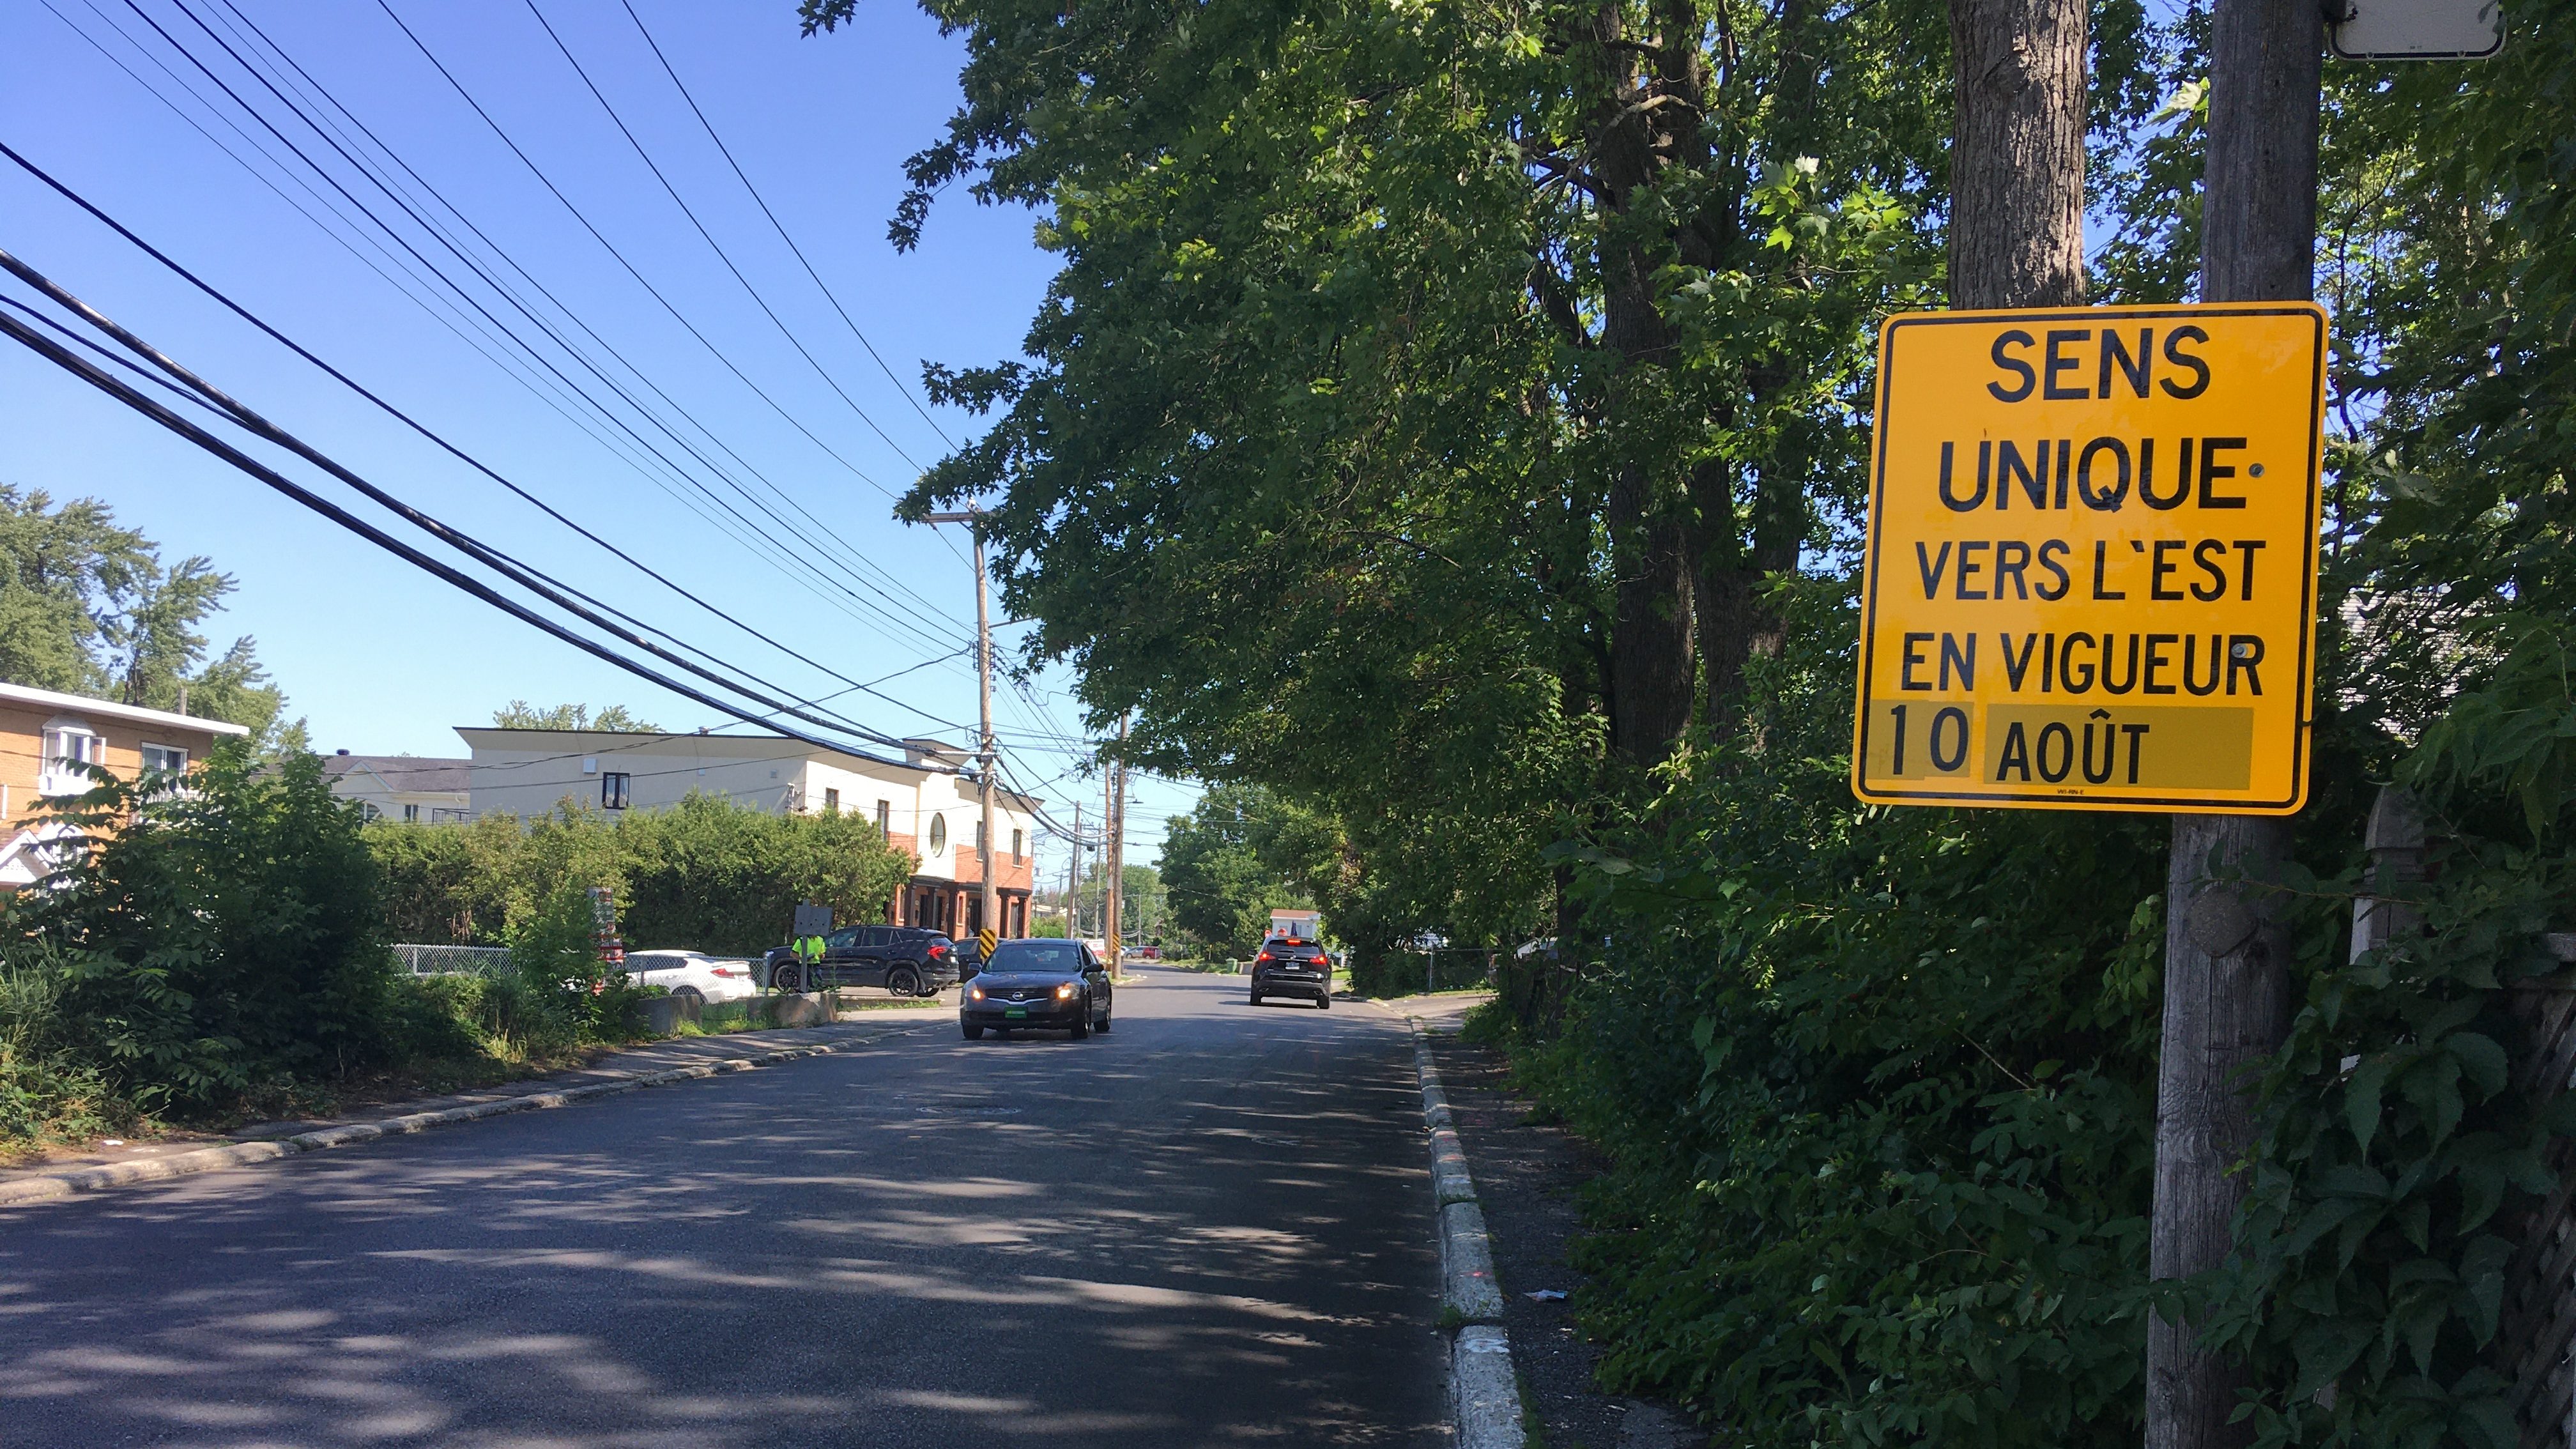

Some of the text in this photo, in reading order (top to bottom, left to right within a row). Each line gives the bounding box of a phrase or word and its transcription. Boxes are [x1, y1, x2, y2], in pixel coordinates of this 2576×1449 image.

[1986, 325, 2211, 403] SENS
[1939, 436, 2248, 513] UNIQUE
[1915, 539, 2071, 602] VERS
[1901, 632, 2265, 696] EN VIGUEUR
[1890, 705, 2150, 785] 10 AOÛT
